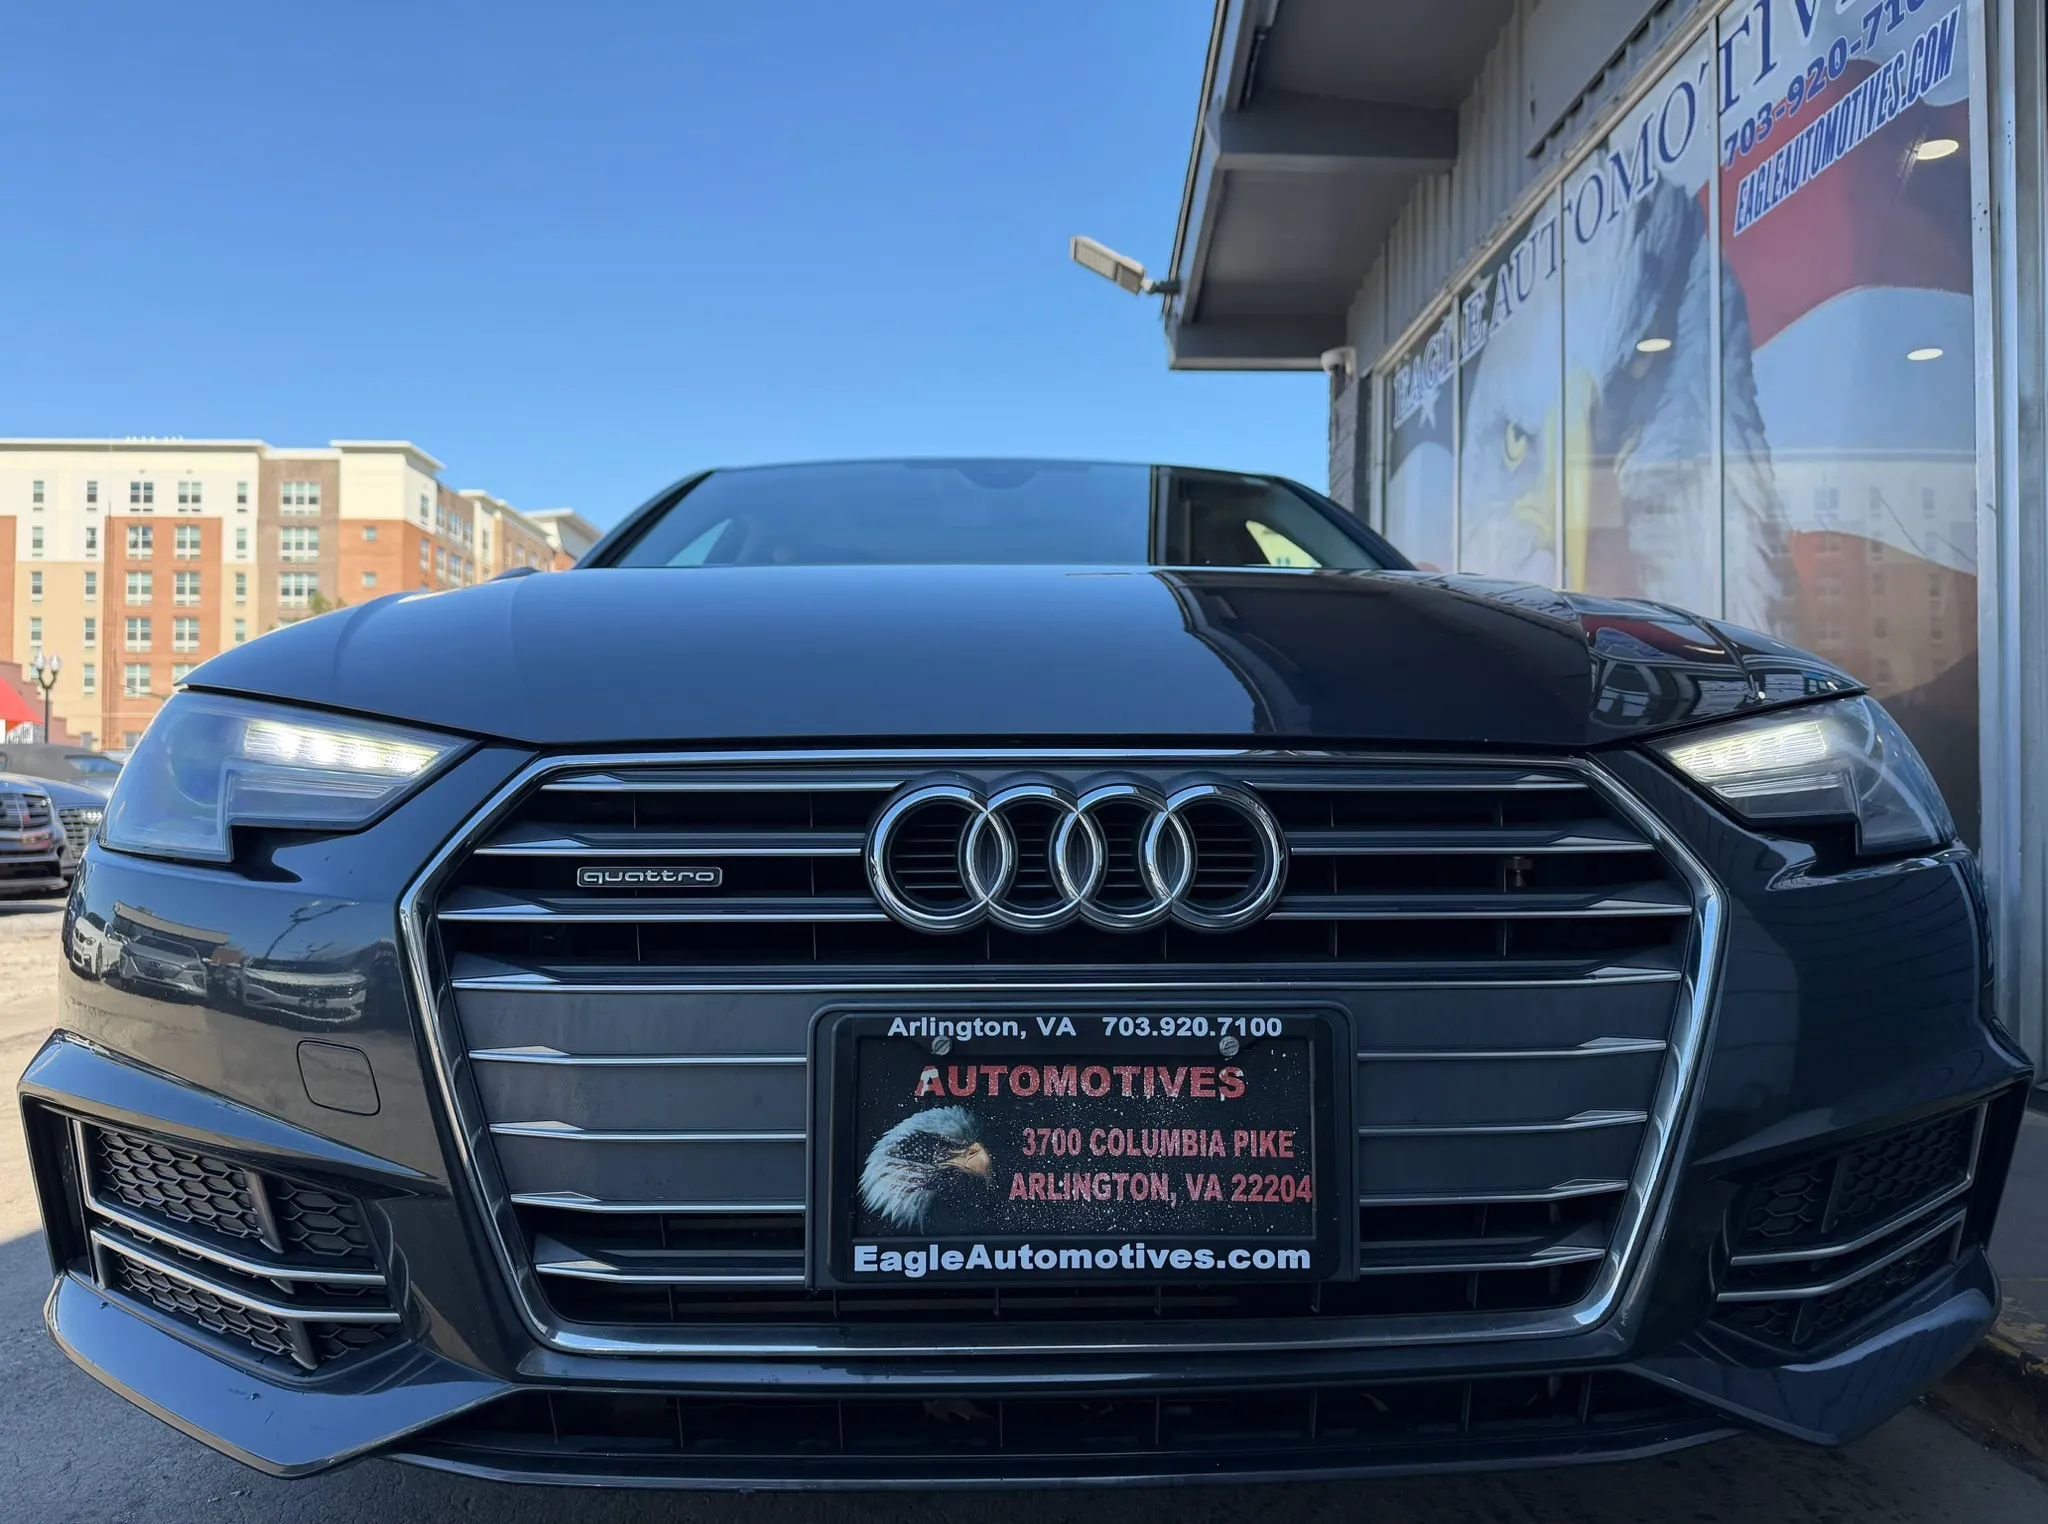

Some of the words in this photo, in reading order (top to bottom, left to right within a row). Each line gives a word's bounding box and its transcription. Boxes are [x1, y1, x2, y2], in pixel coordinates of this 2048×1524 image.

[1723, 0, 1926, 171] 703-920-71
[1734, 5, 1960, 237] EAGLEAUTOMOTIVES.COM
[1393, 289, 1489, 428] EAGLE
[1491, 0, 1851, 332] AUTOMOTIV
[583, 869, 715, 884] quattro
[887, 1016, 1027, 1041] Arlington,
[1036, 1016, 1077, 1037] VA
[1102, 1016, 1283, 1037] 703.920.7100
[914, 1065, 1247, 1098] AUTOMOTIVES
[1022, 1127, 1082, 1156] 3700
[1090, 1128, 1227, 1158] COLUMBIA
[1233, 1130, 1294, 1158] PIKE
[1008, 1172, 1177, 1208] ARLINGTON,
[1185, 1173, 1225, 1201] VA
[1231, 1174, 1312, 1203] 22204
[853, 1243, 1311, 1278] EagleAutomotives.com
